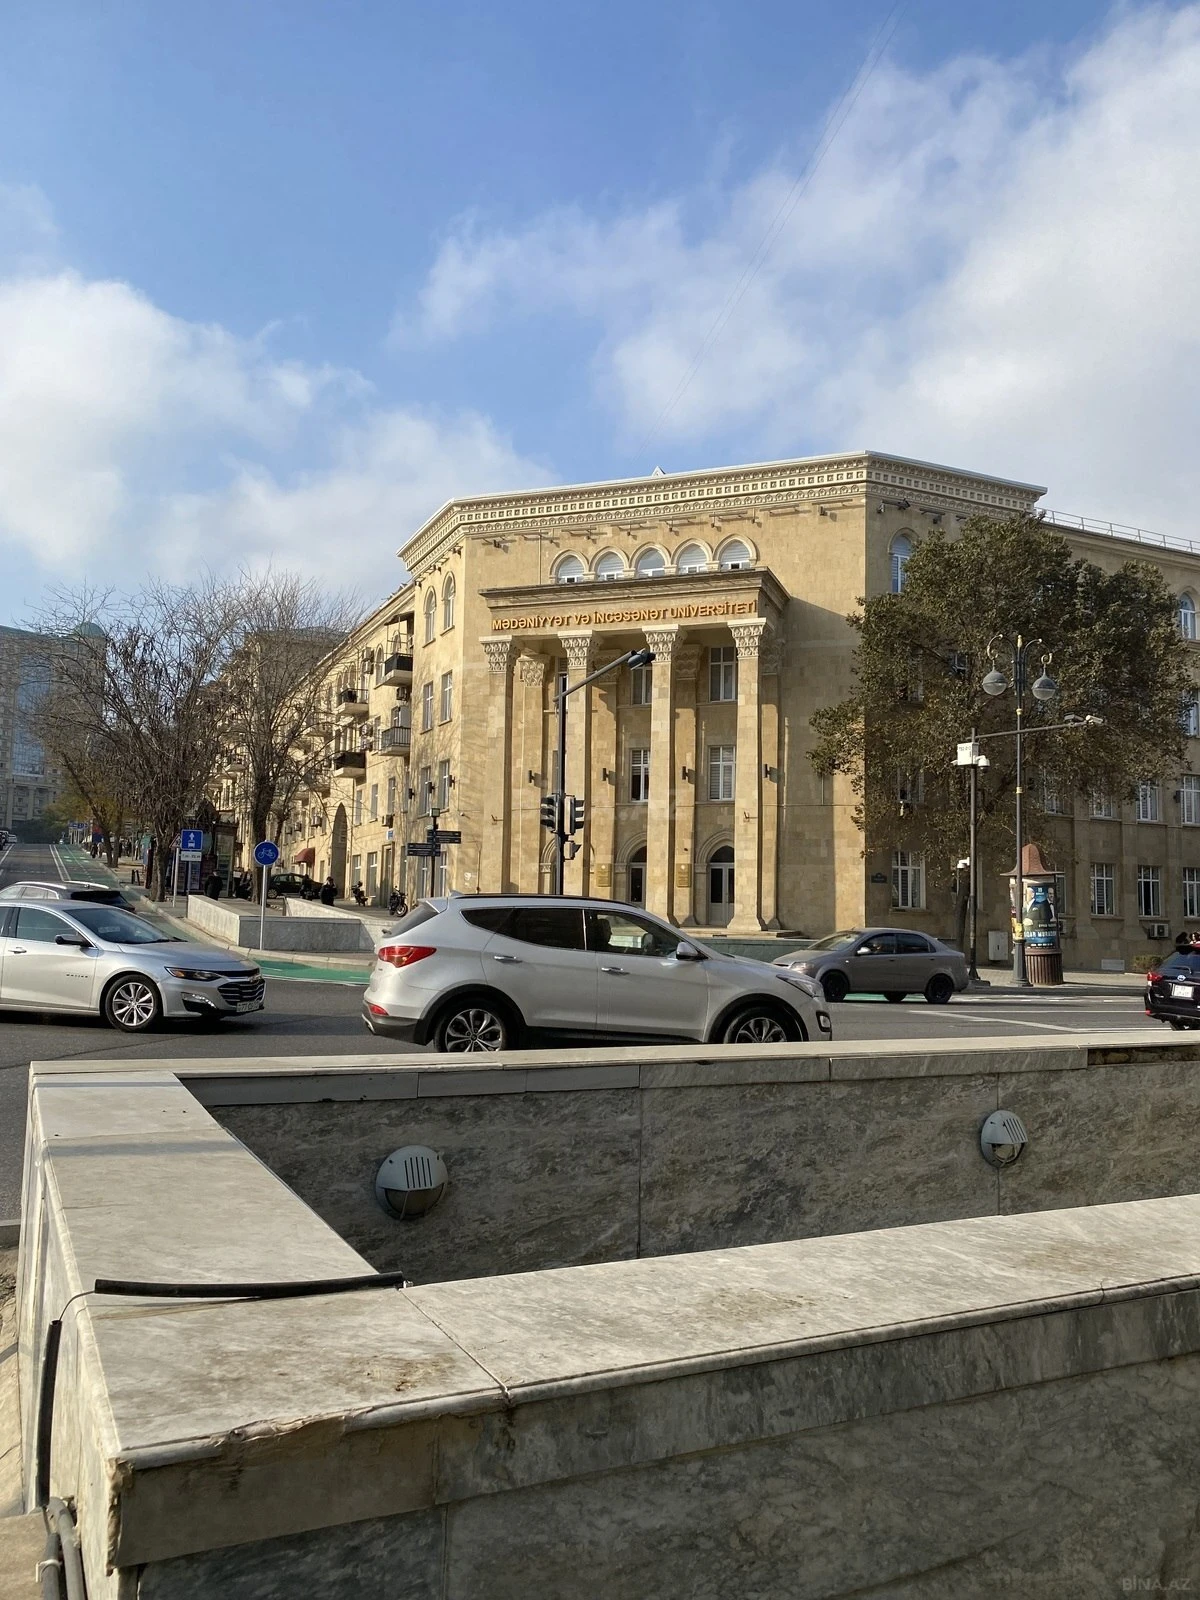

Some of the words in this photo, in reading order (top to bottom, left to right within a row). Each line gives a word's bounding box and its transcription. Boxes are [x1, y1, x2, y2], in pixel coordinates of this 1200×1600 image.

[492, 615, 571, 630] MƏDƏNİYYƏT
[573, 612, 590, 625] VƏ
[593, 609, 668, 624] İNCƏSƏNƏT
[670, 600, 757, 618] UNİVERSİTETİ
